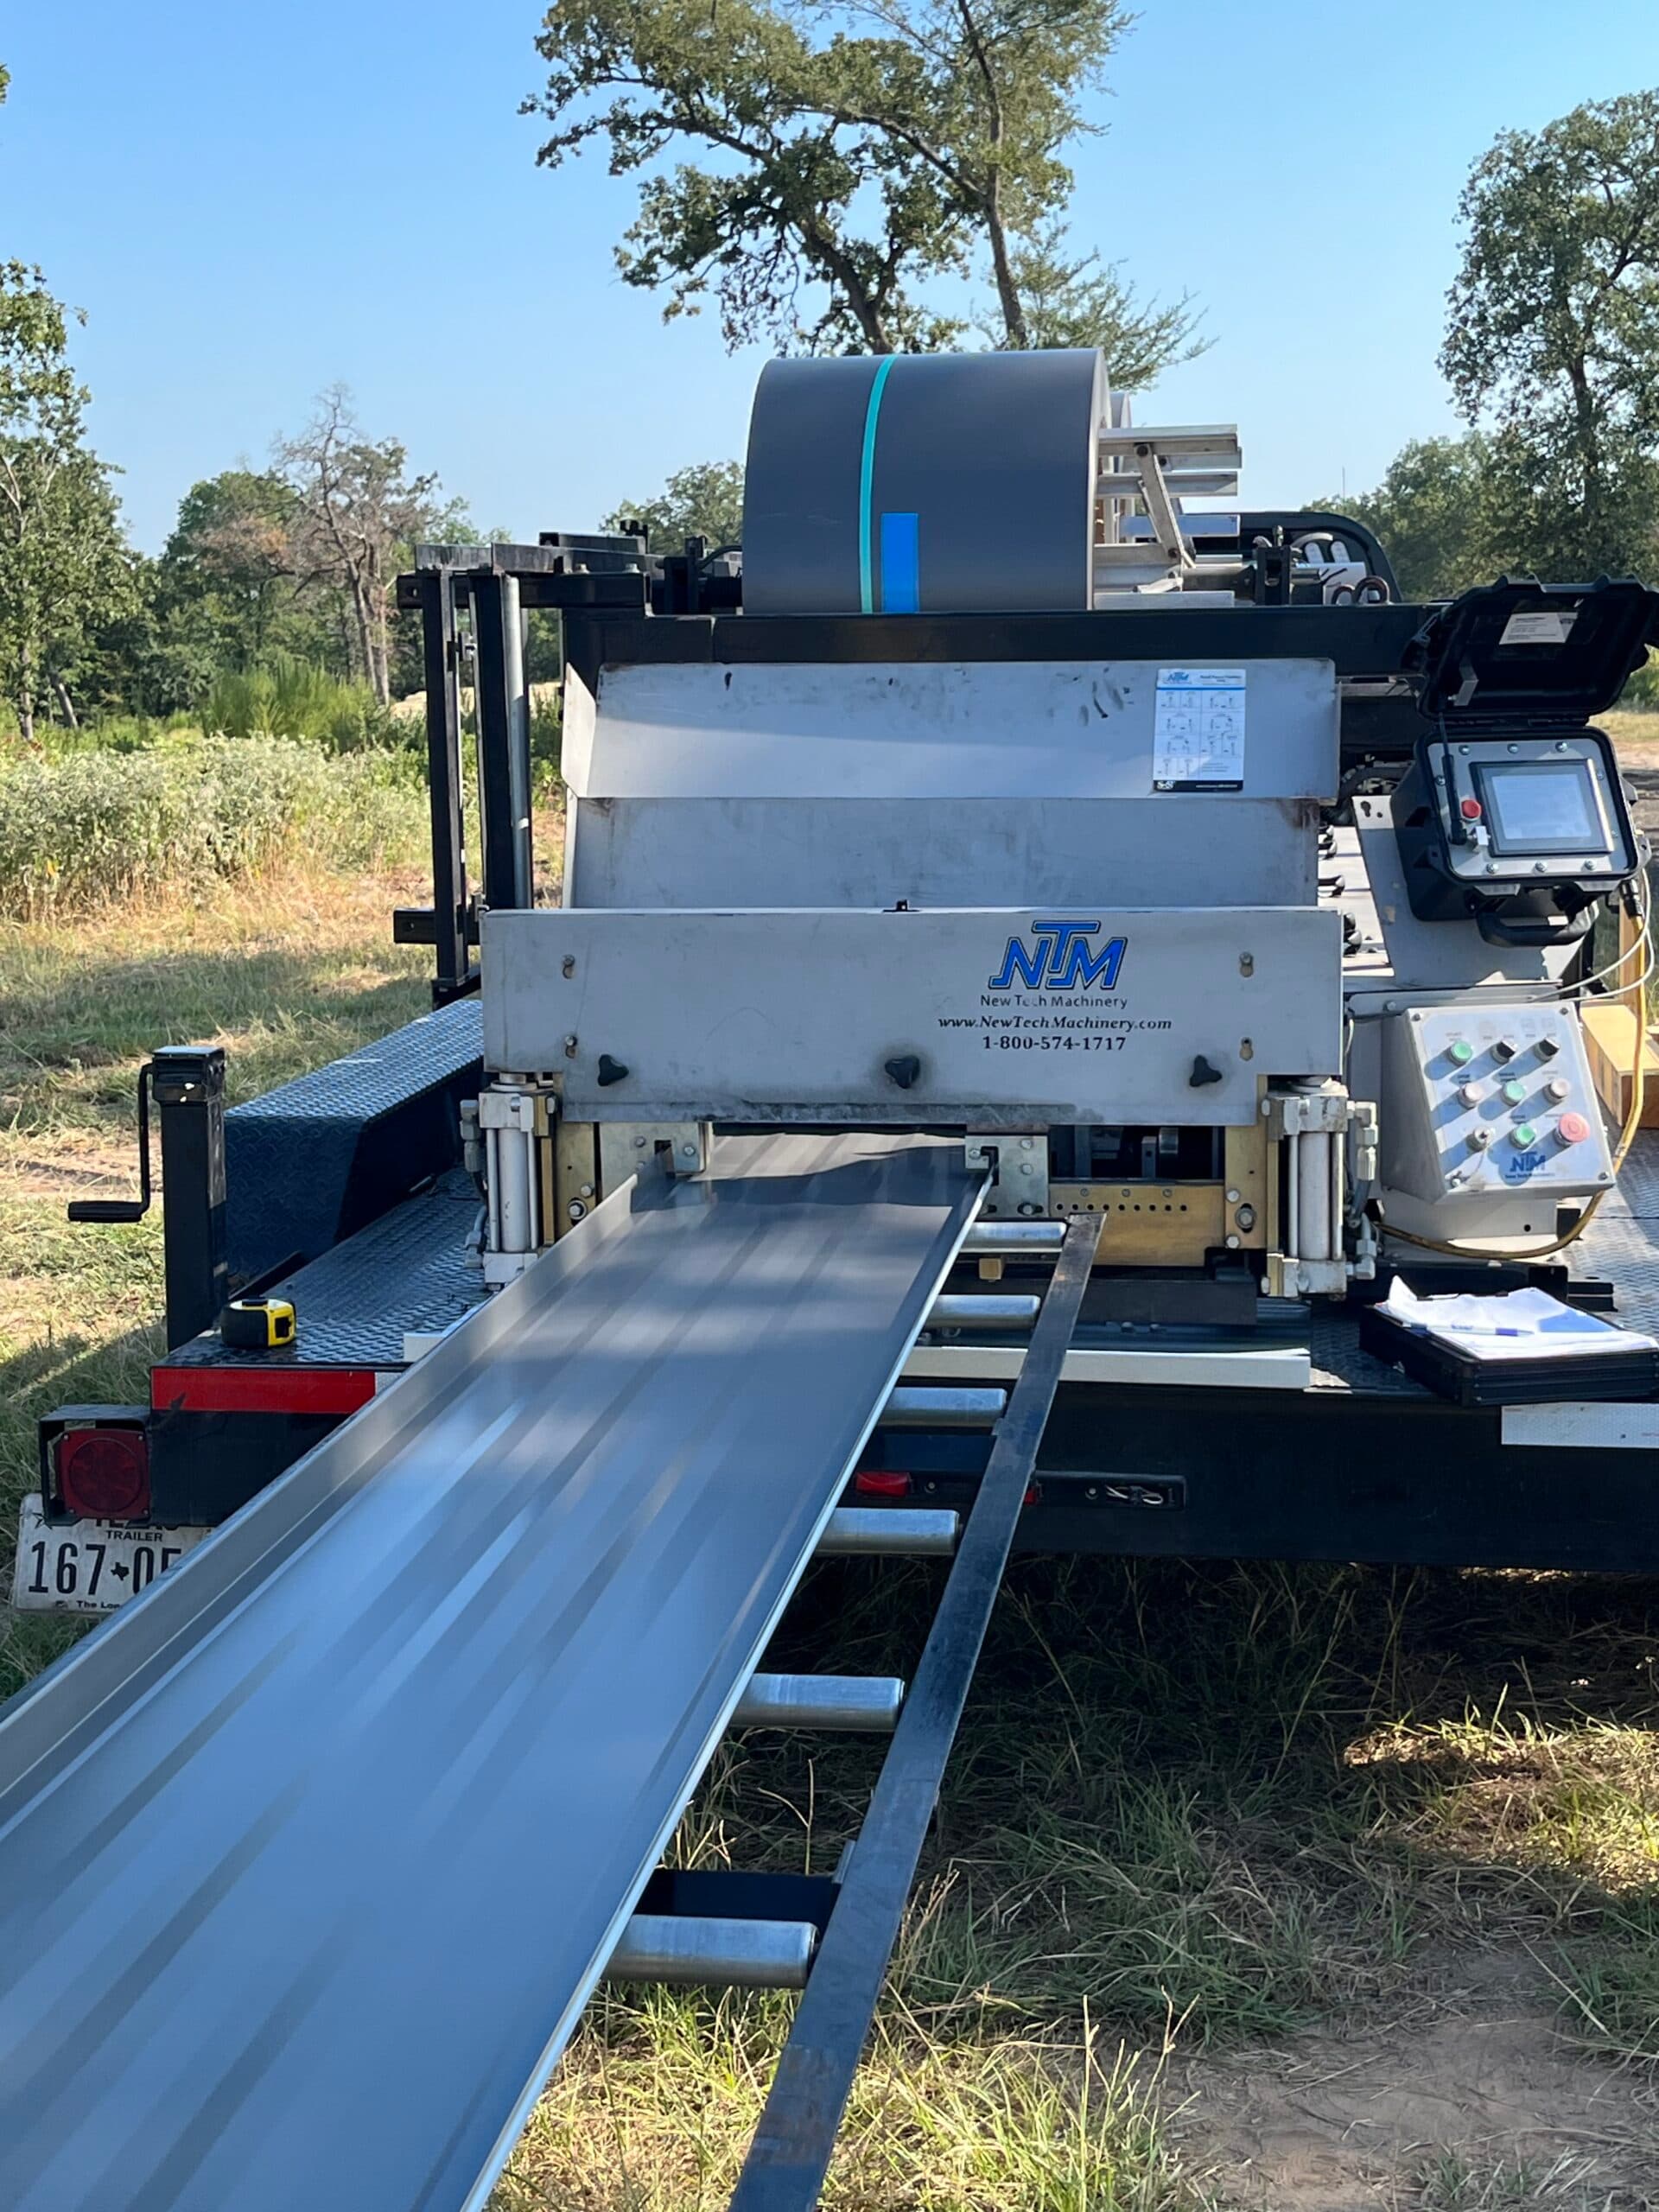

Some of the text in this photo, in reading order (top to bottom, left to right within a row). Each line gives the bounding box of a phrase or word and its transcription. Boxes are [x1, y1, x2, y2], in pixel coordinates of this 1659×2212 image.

[988, 920, 1128, 989] NTM
[981, 995, 1011, 1007] New
[1051, 995, 1128, 1009] Machinery
[938, 1015, 1172, 1033] www.NewTechMachinery.com
[983, 1036, 1127, 1051] 1-800-574-1717
[106, 1530, 163, 1542] TRAILER
[29, 1541, 106, 1596] 167
